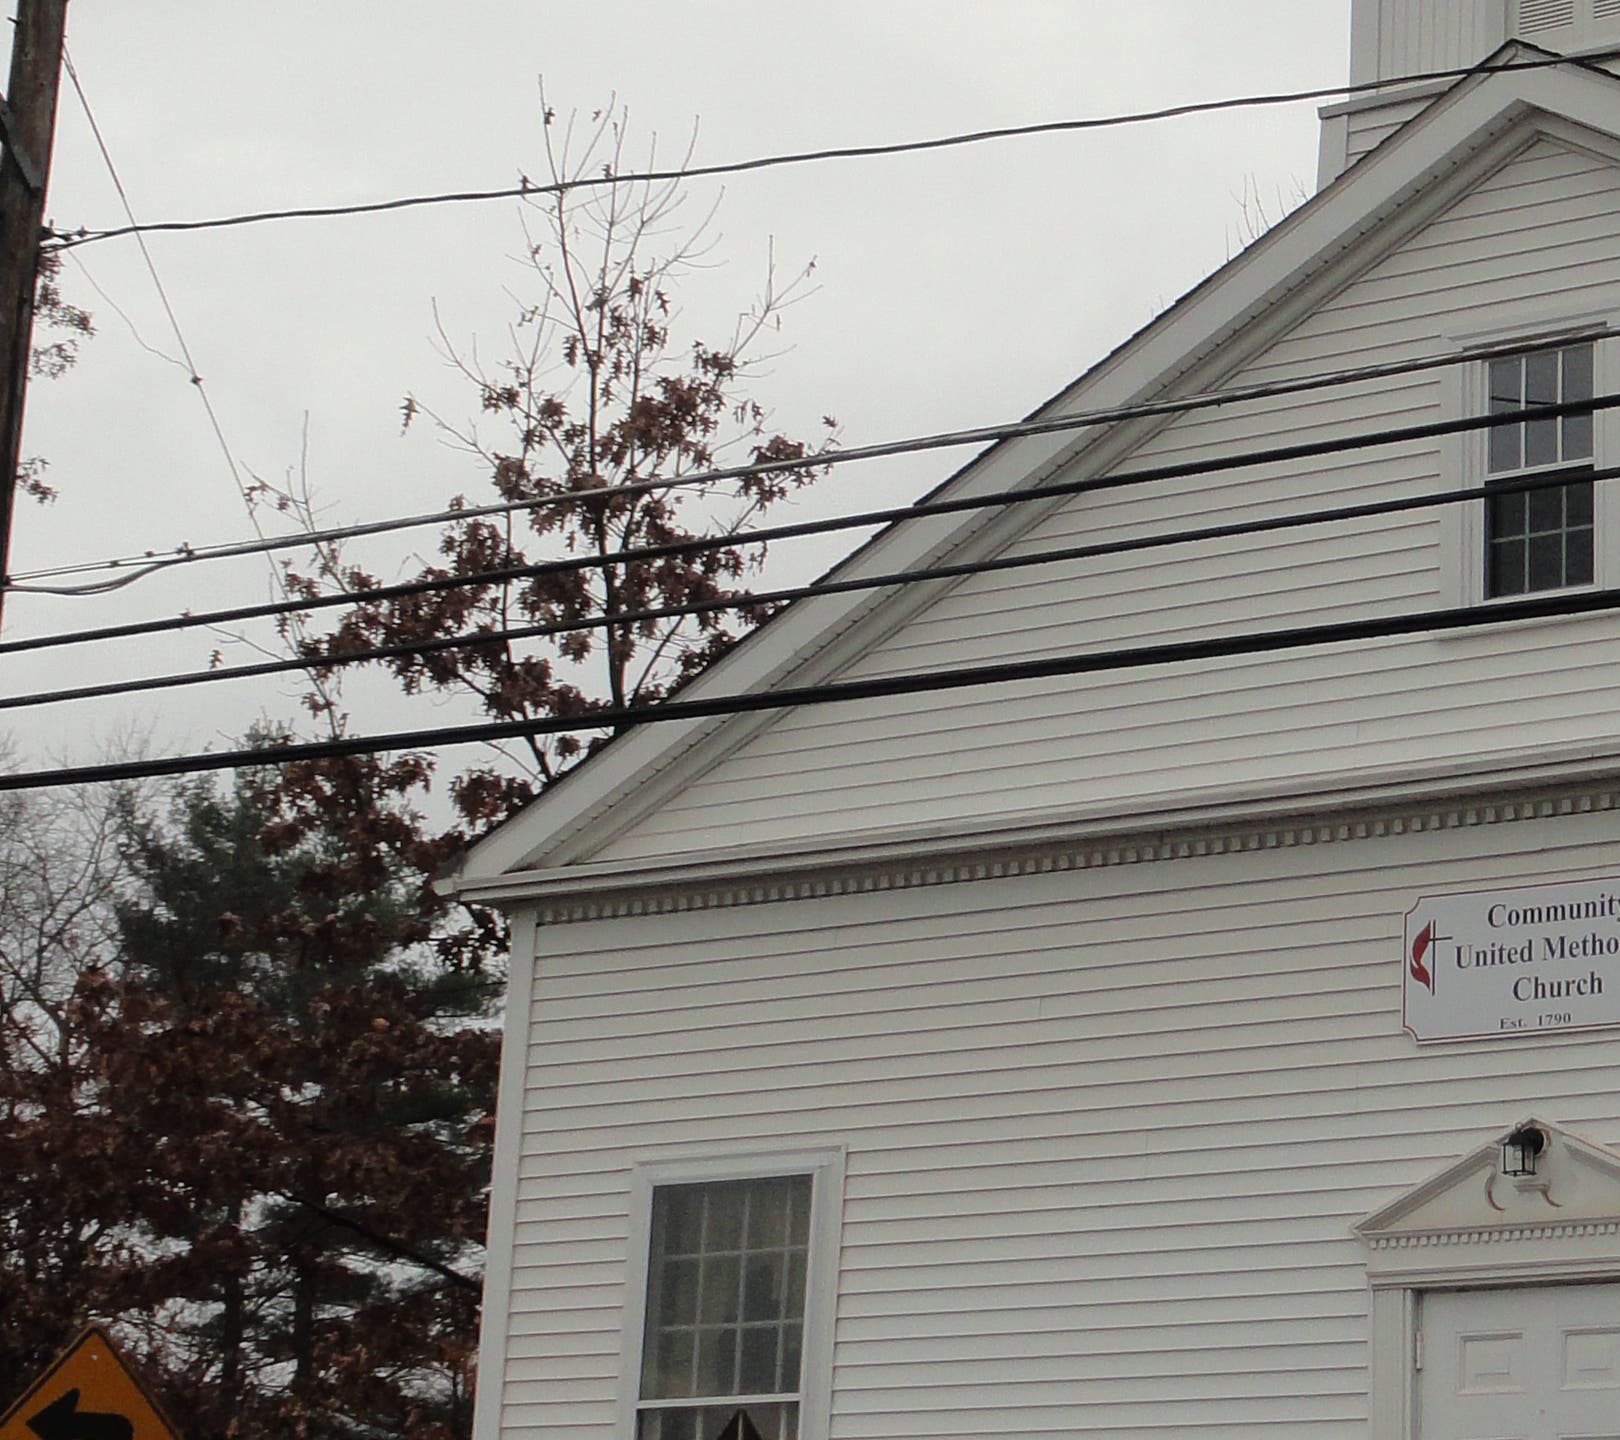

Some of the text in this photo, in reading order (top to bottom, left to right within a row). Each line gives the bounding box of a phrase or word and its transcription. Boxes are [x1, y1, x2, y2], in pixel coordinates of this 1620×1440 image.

[1455, 939, 1534, 969] United
[1512, 971, 1603, 1002] Church
[1499, 1012, 1572, 1030] Est. 1790
